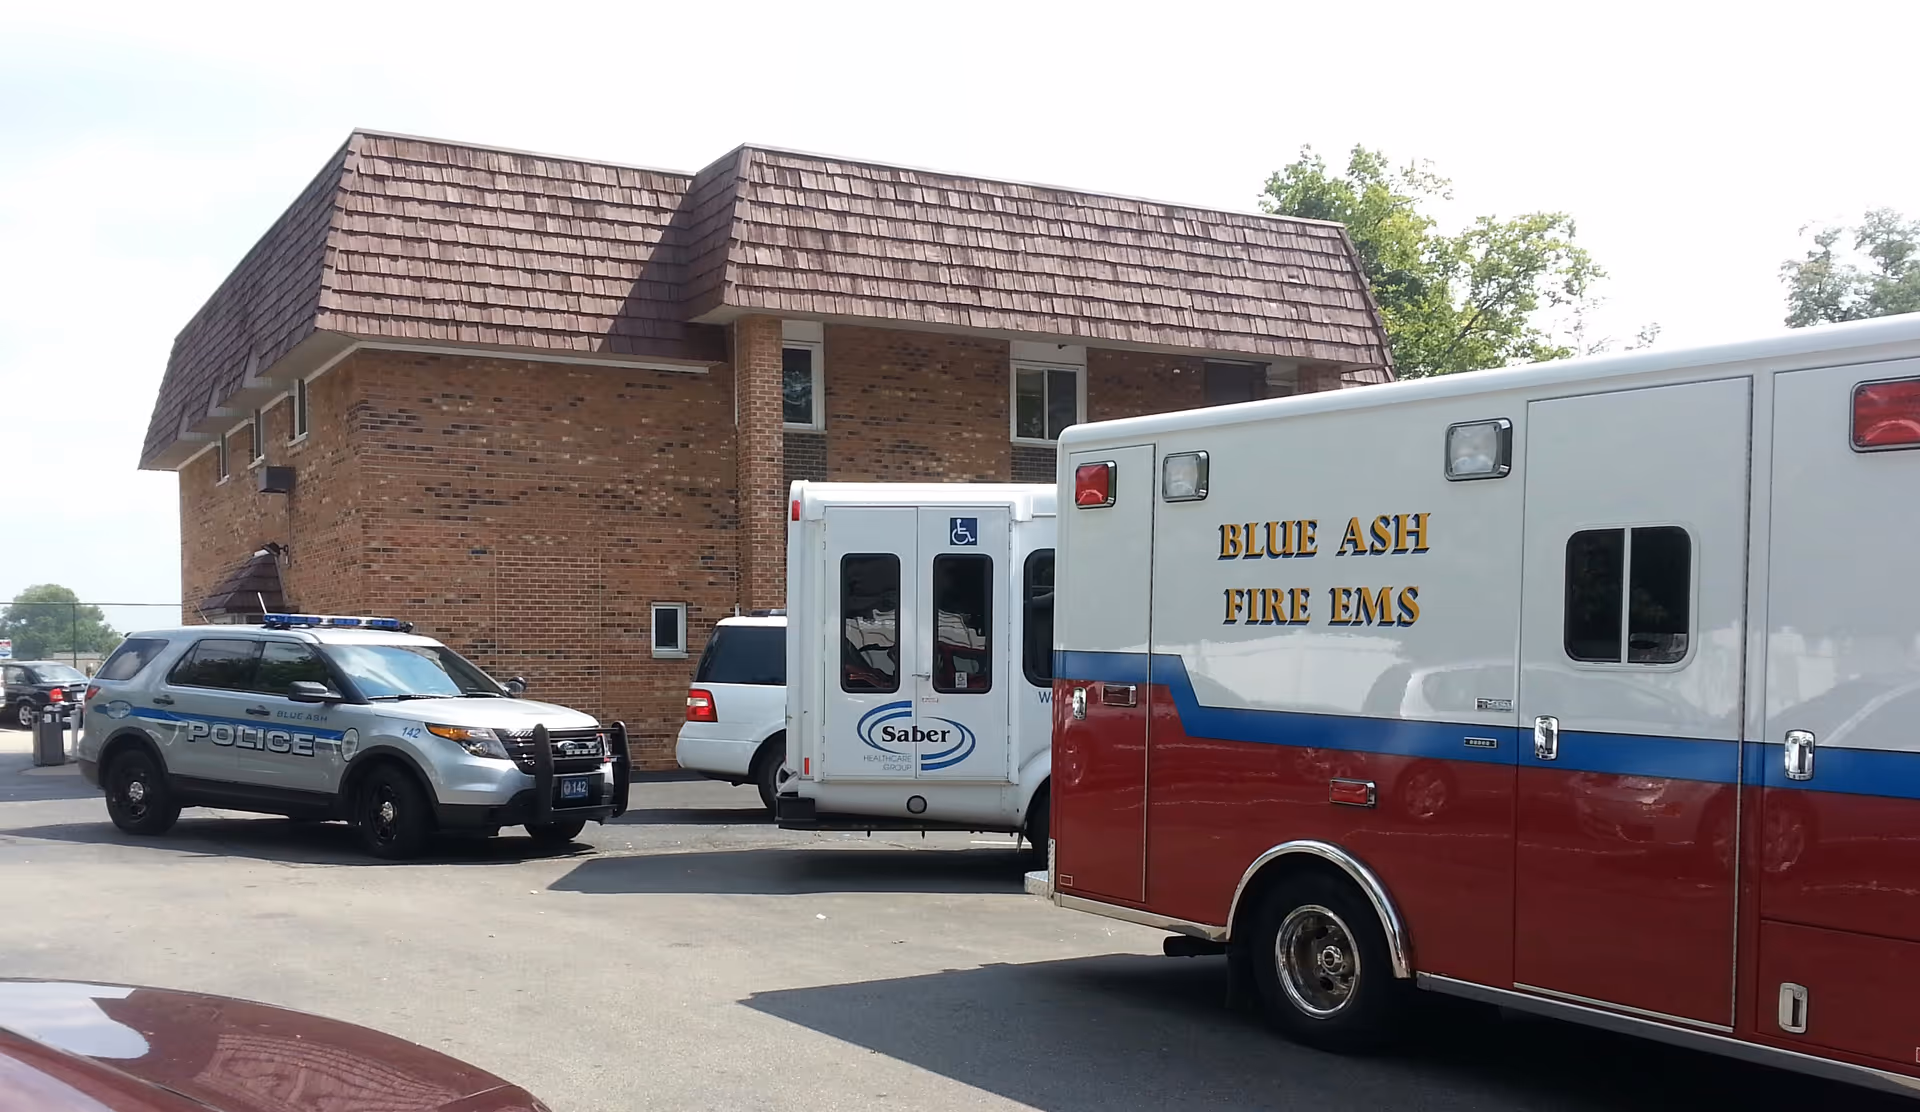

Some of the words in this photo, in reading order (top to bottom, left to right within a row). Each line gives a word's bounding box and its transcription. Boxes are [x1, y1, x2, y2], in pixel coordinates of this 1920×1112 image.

[1217, 519, 1319, 560] BLUE
[1335, 513, 1431, 556] ASH
[1222, 587, 1311, 626] FIRE
[1328, 586, 1421, 627] EMS
[276, 710, 303, 720] BLUE
[305, 713, 328, 722] ASH
[186, 720, 315, 757] POLICE
[402, 726, 421, 739] 142
[881, 725, 951, 743] Saber
[863, 755, 912, 763] HEALTHCARE
[572, 781, 587, 794] 142
